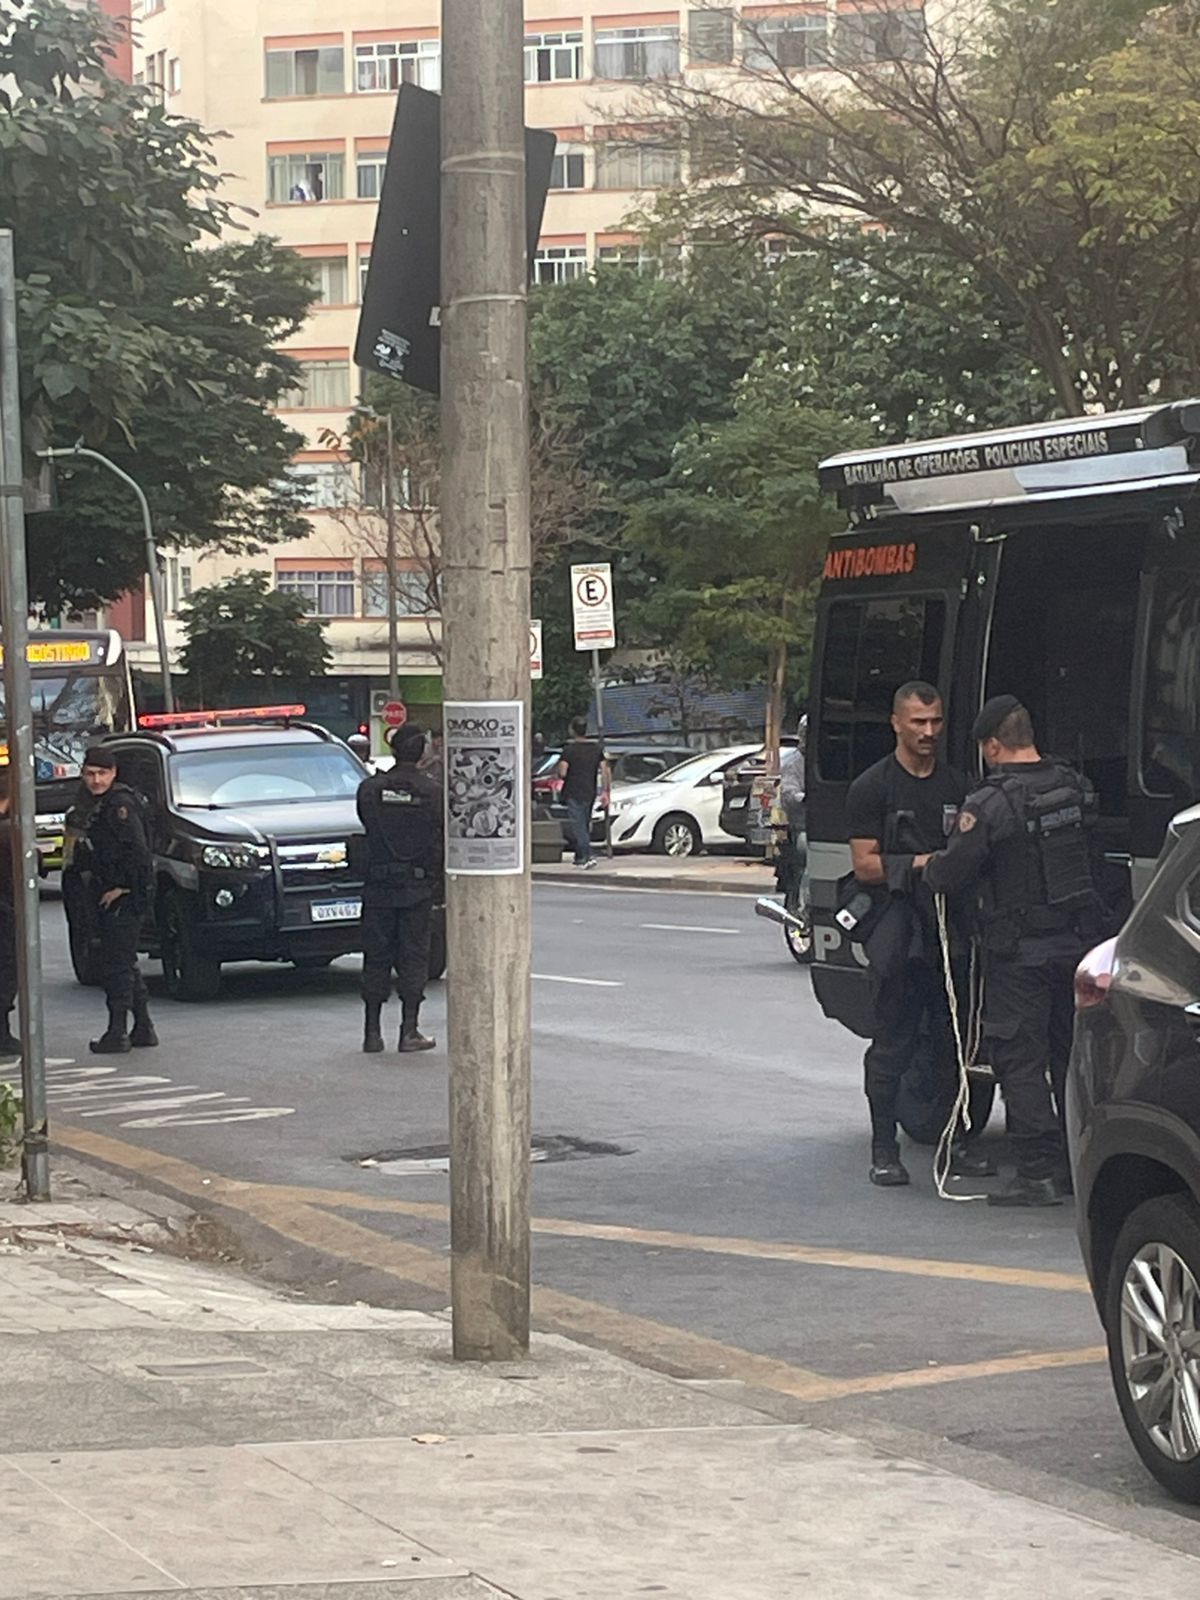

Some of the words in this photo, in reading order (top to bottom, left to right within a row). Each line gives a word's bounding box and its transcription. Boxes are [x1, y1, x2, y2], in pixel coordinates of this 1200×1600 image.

[898, 458, 914, 479] DE
[984, 440, 1042, 467] POLICIAIS
[1044, 431, 1109, 459] ESPECIAIS
[822, 543, 916, 580] ANTIBOMBAS
[586, 580, 598, 601] E
